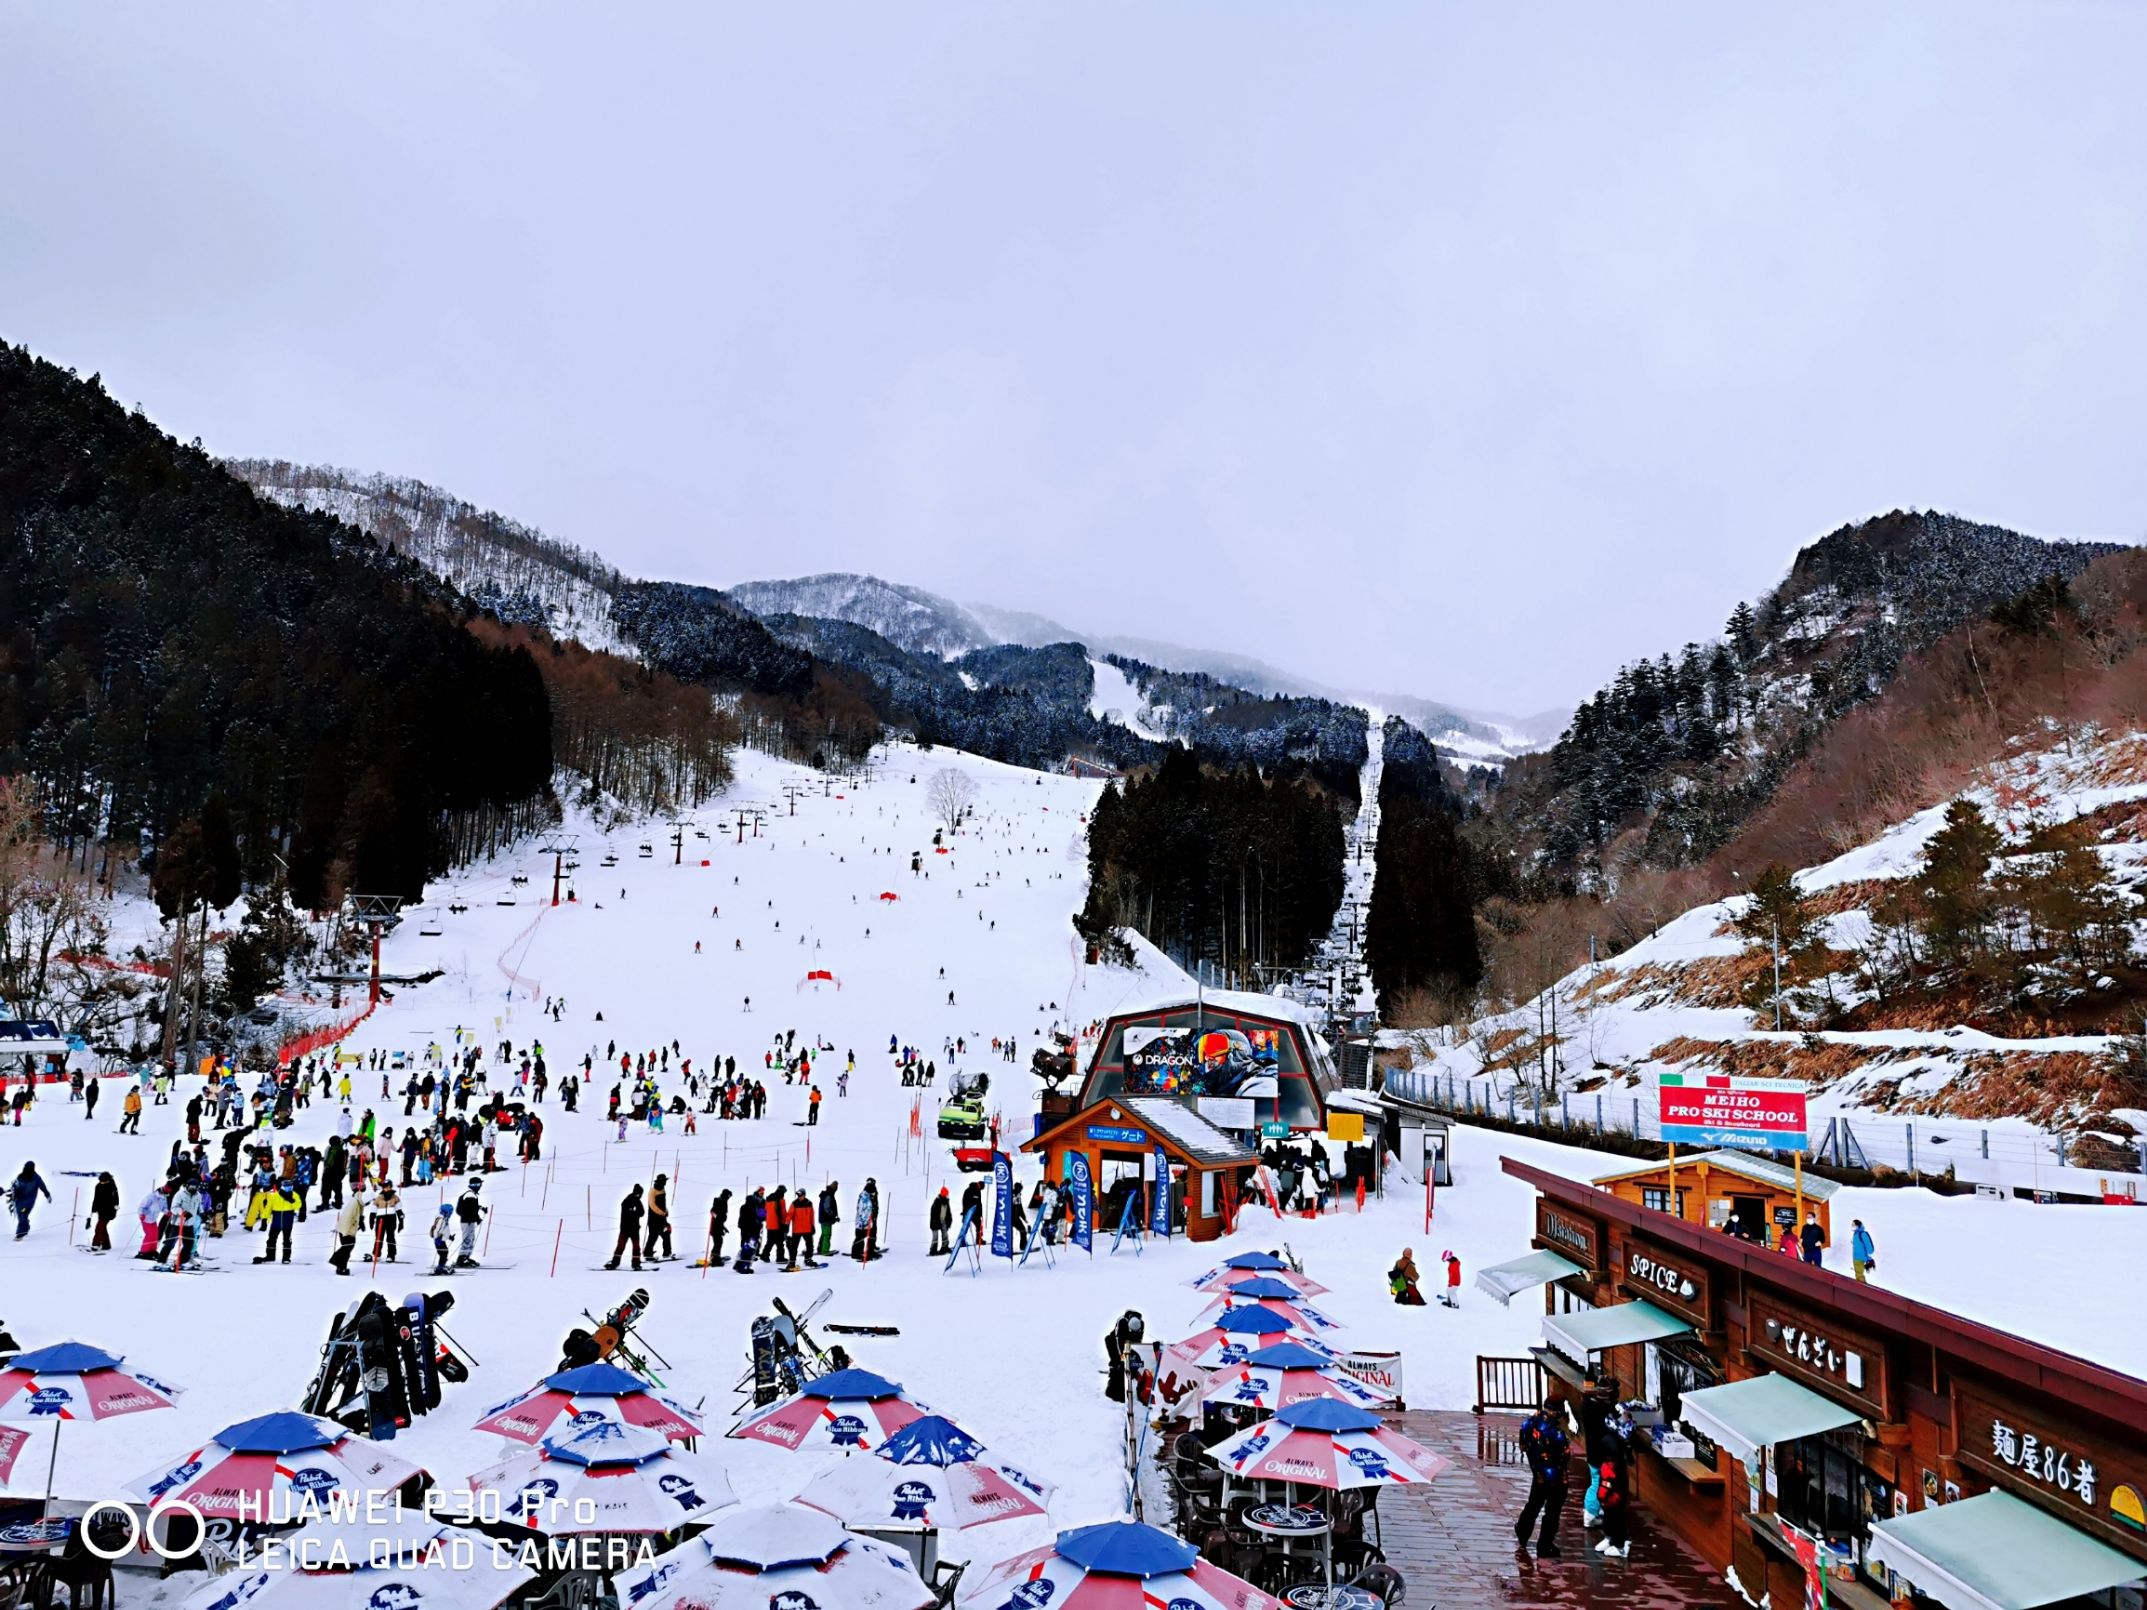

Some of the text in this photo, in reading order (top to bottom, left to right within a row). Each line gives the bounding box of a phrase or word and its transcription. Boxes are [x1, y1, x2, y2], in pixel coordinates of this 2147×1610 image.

[1145, 1054, 1193, 1066] DRAGON
[1704, 1095, 1760, 1107] MEIHO
[1668, 1106, 1798, 1123] PRO SKI SCHOOL
[1631, 1254, 1678, 1293] SPICE
[1782, 1325, 1841, 1372] ぜんざい
[1348, 1361, 1377, 1370] ALWAYS
[1285, 1458, 1314, 1467] ALWAYS
[1265, 1461, 1328, 1480] ORIGINAL
[300, 1473, 323, 1483] Pabst
